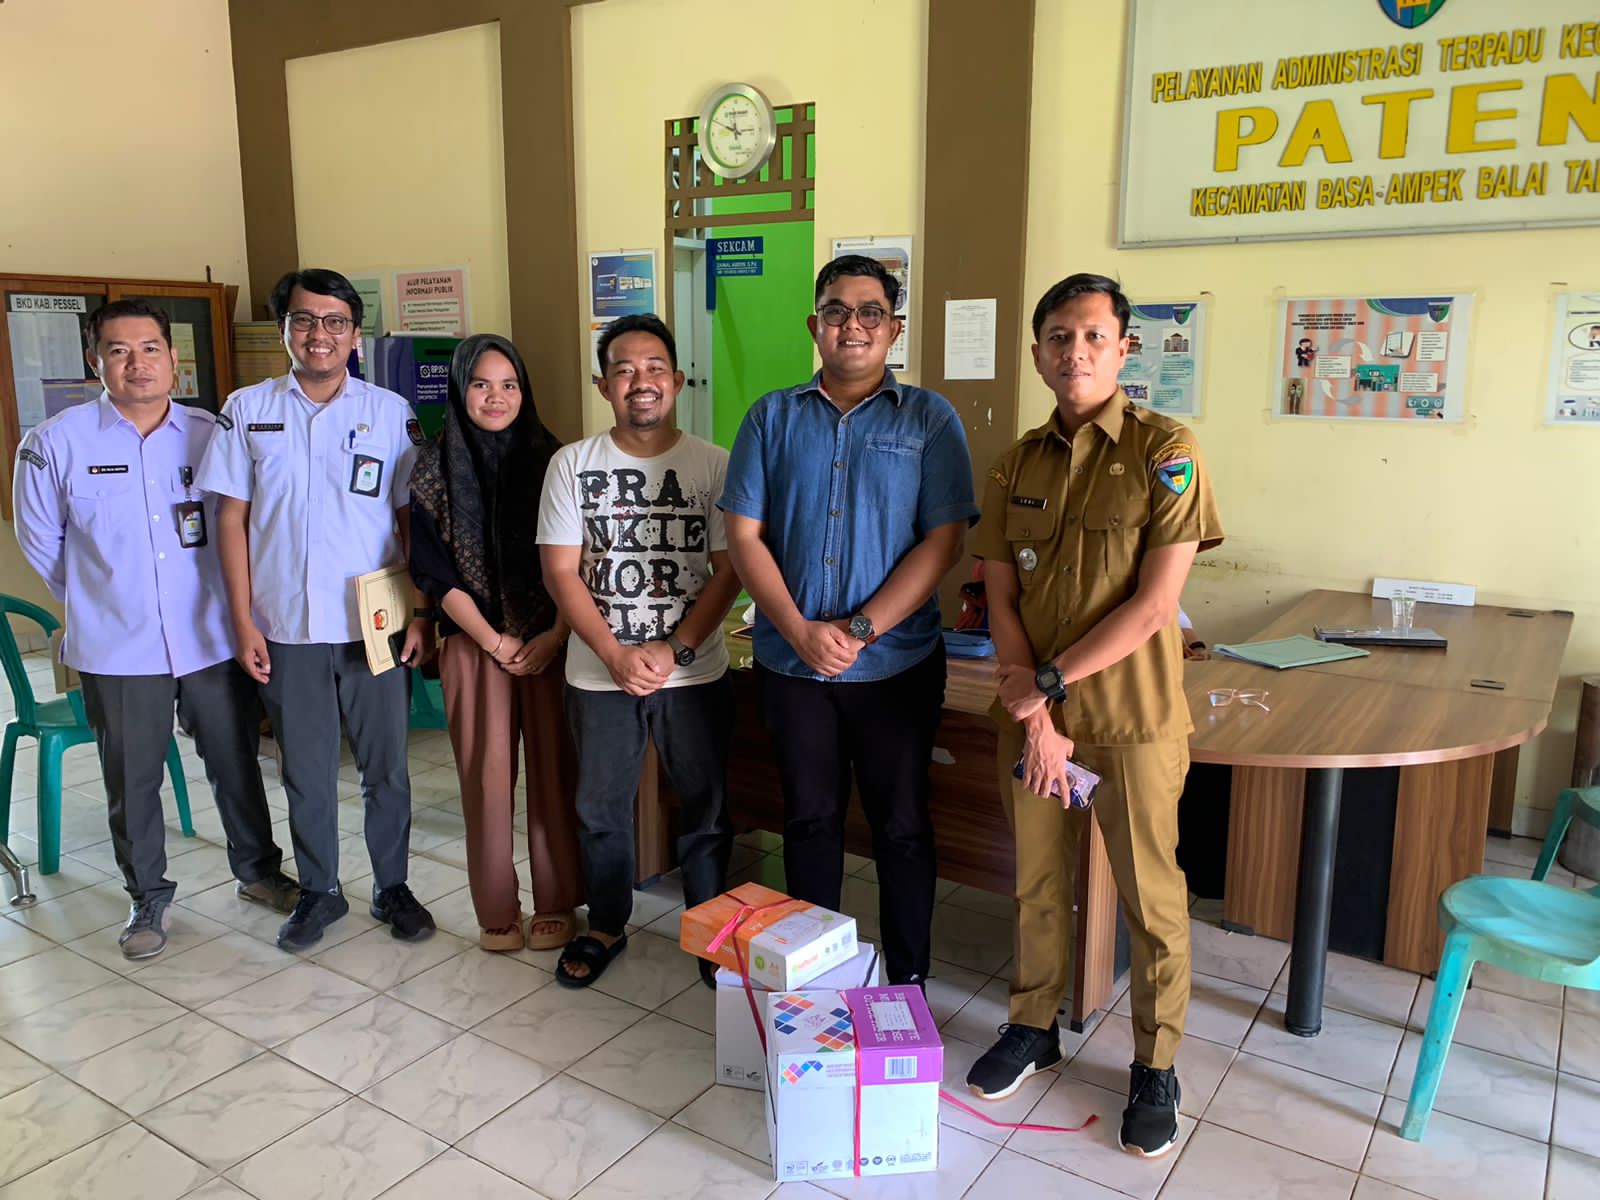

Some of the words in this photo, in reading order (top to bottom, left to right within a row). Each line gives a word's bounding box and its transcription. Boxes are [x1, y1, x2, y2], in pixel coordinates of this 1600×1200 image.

[1152, 63, 1262, 102] PELAYANAN
[1273, 43, 1424, 90] ADMINISTRASI
[1438, 27, 1546, 72] TERPADU
[1213, 71, 1600, 172] PATEN
[1190, 181, 1306, 217] KECAMATAN
[1318, 175, 1374, 209] BASA
[1386, 168, 1466, 206] AMPEK
[1478, 161, 1549, 200] BALAI
[1564, 159, 1600, 194] TA
[717, 240, 755, 252] SEKCAM
[420, 277, 451, 285] PELAYANAN
[434, 286, 453, 294] PUBLIK
[16, 298, 33, 309] BKD
[34, 298, 51, 309] KAB.
[53, 298, 81, 310] PESSEL
[431, 365, 444, 373] BPJS
[584, 513, 706, 553] NKIE
[588, 558, 687, 598] MOR
